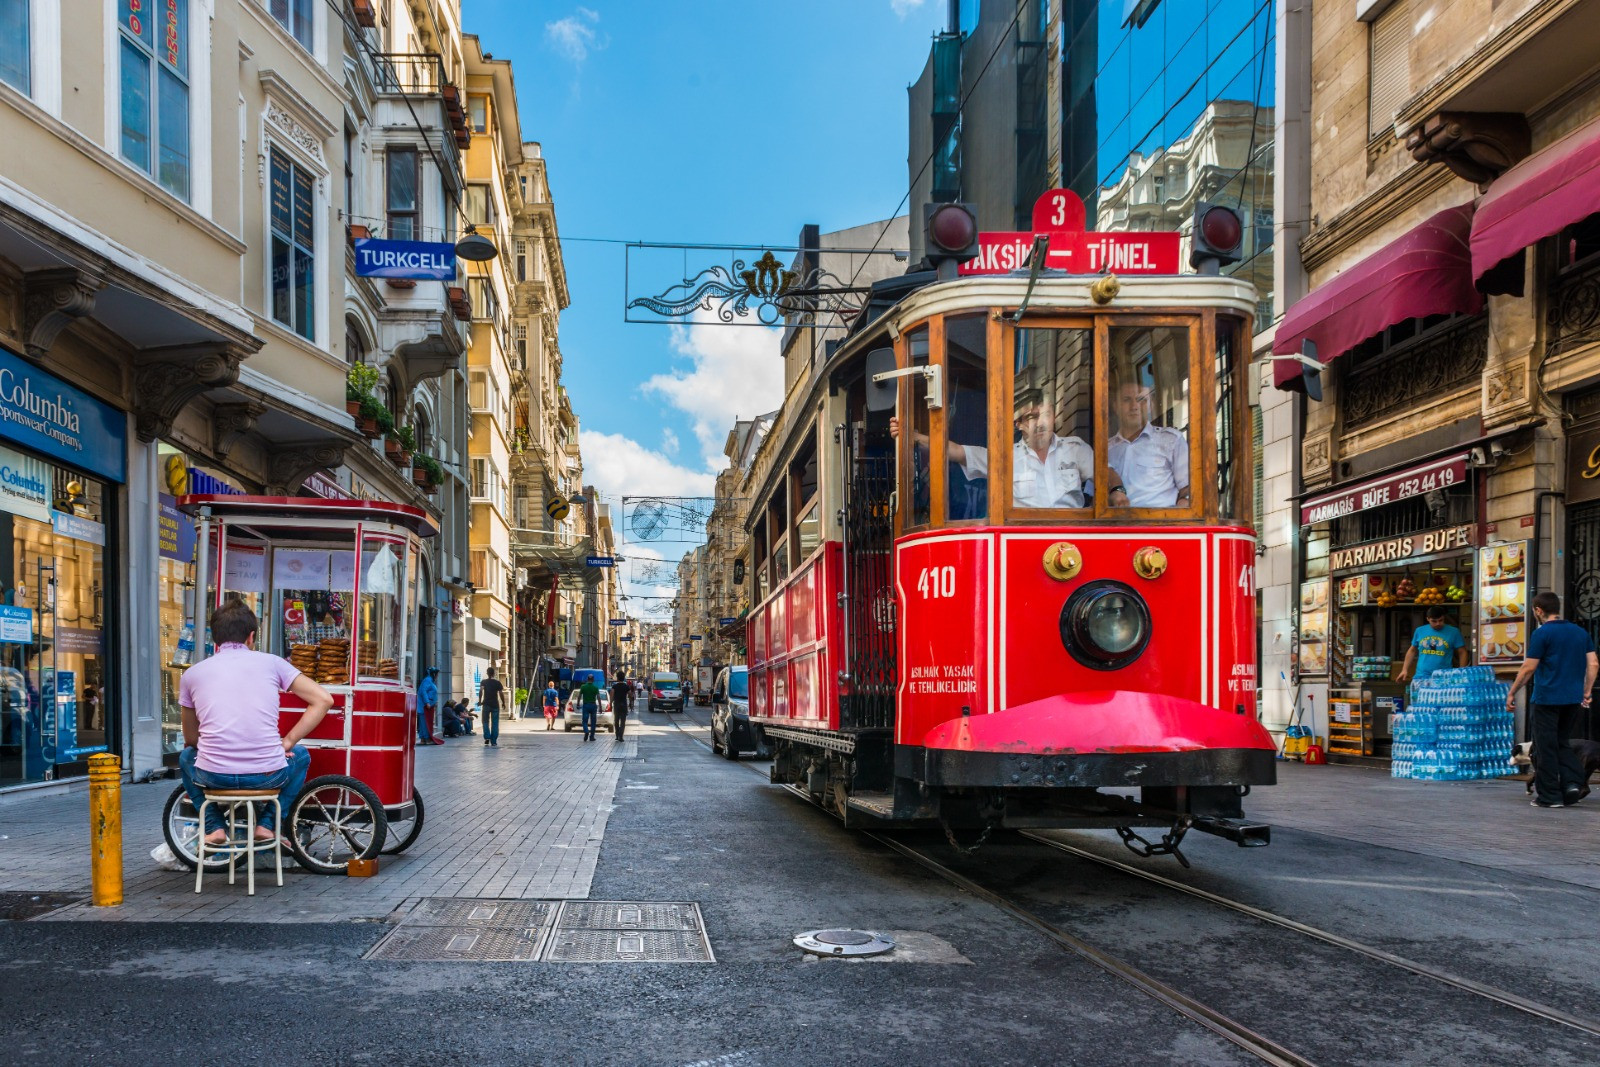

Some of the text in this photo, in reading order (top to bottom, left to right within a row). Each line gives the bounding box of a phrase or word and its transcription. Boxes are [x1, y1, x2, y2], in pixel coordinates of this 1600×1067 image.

[1051, 195, 1066, 226] 3
[361, 248, 453, 271] TURKCELL
[1086, 238, 1157, 270] TÜNEL
[0, 368, 80, 434] Columbia
[1, 466, 45, 496] Columbia
[1309, 468, 1454, 522] MARMARİS BÜFE 252 44 19
[159, 516, 178, 531] ATURALI
[1333, 537, 1412, 570] MARMARİS
[917, 565, 956, 600] 410
[1238, 564, 1256, 597] 41
[911, 665, 975, 679] ASILMAK YASAK
[1227, 679, 1239, 692] VE
